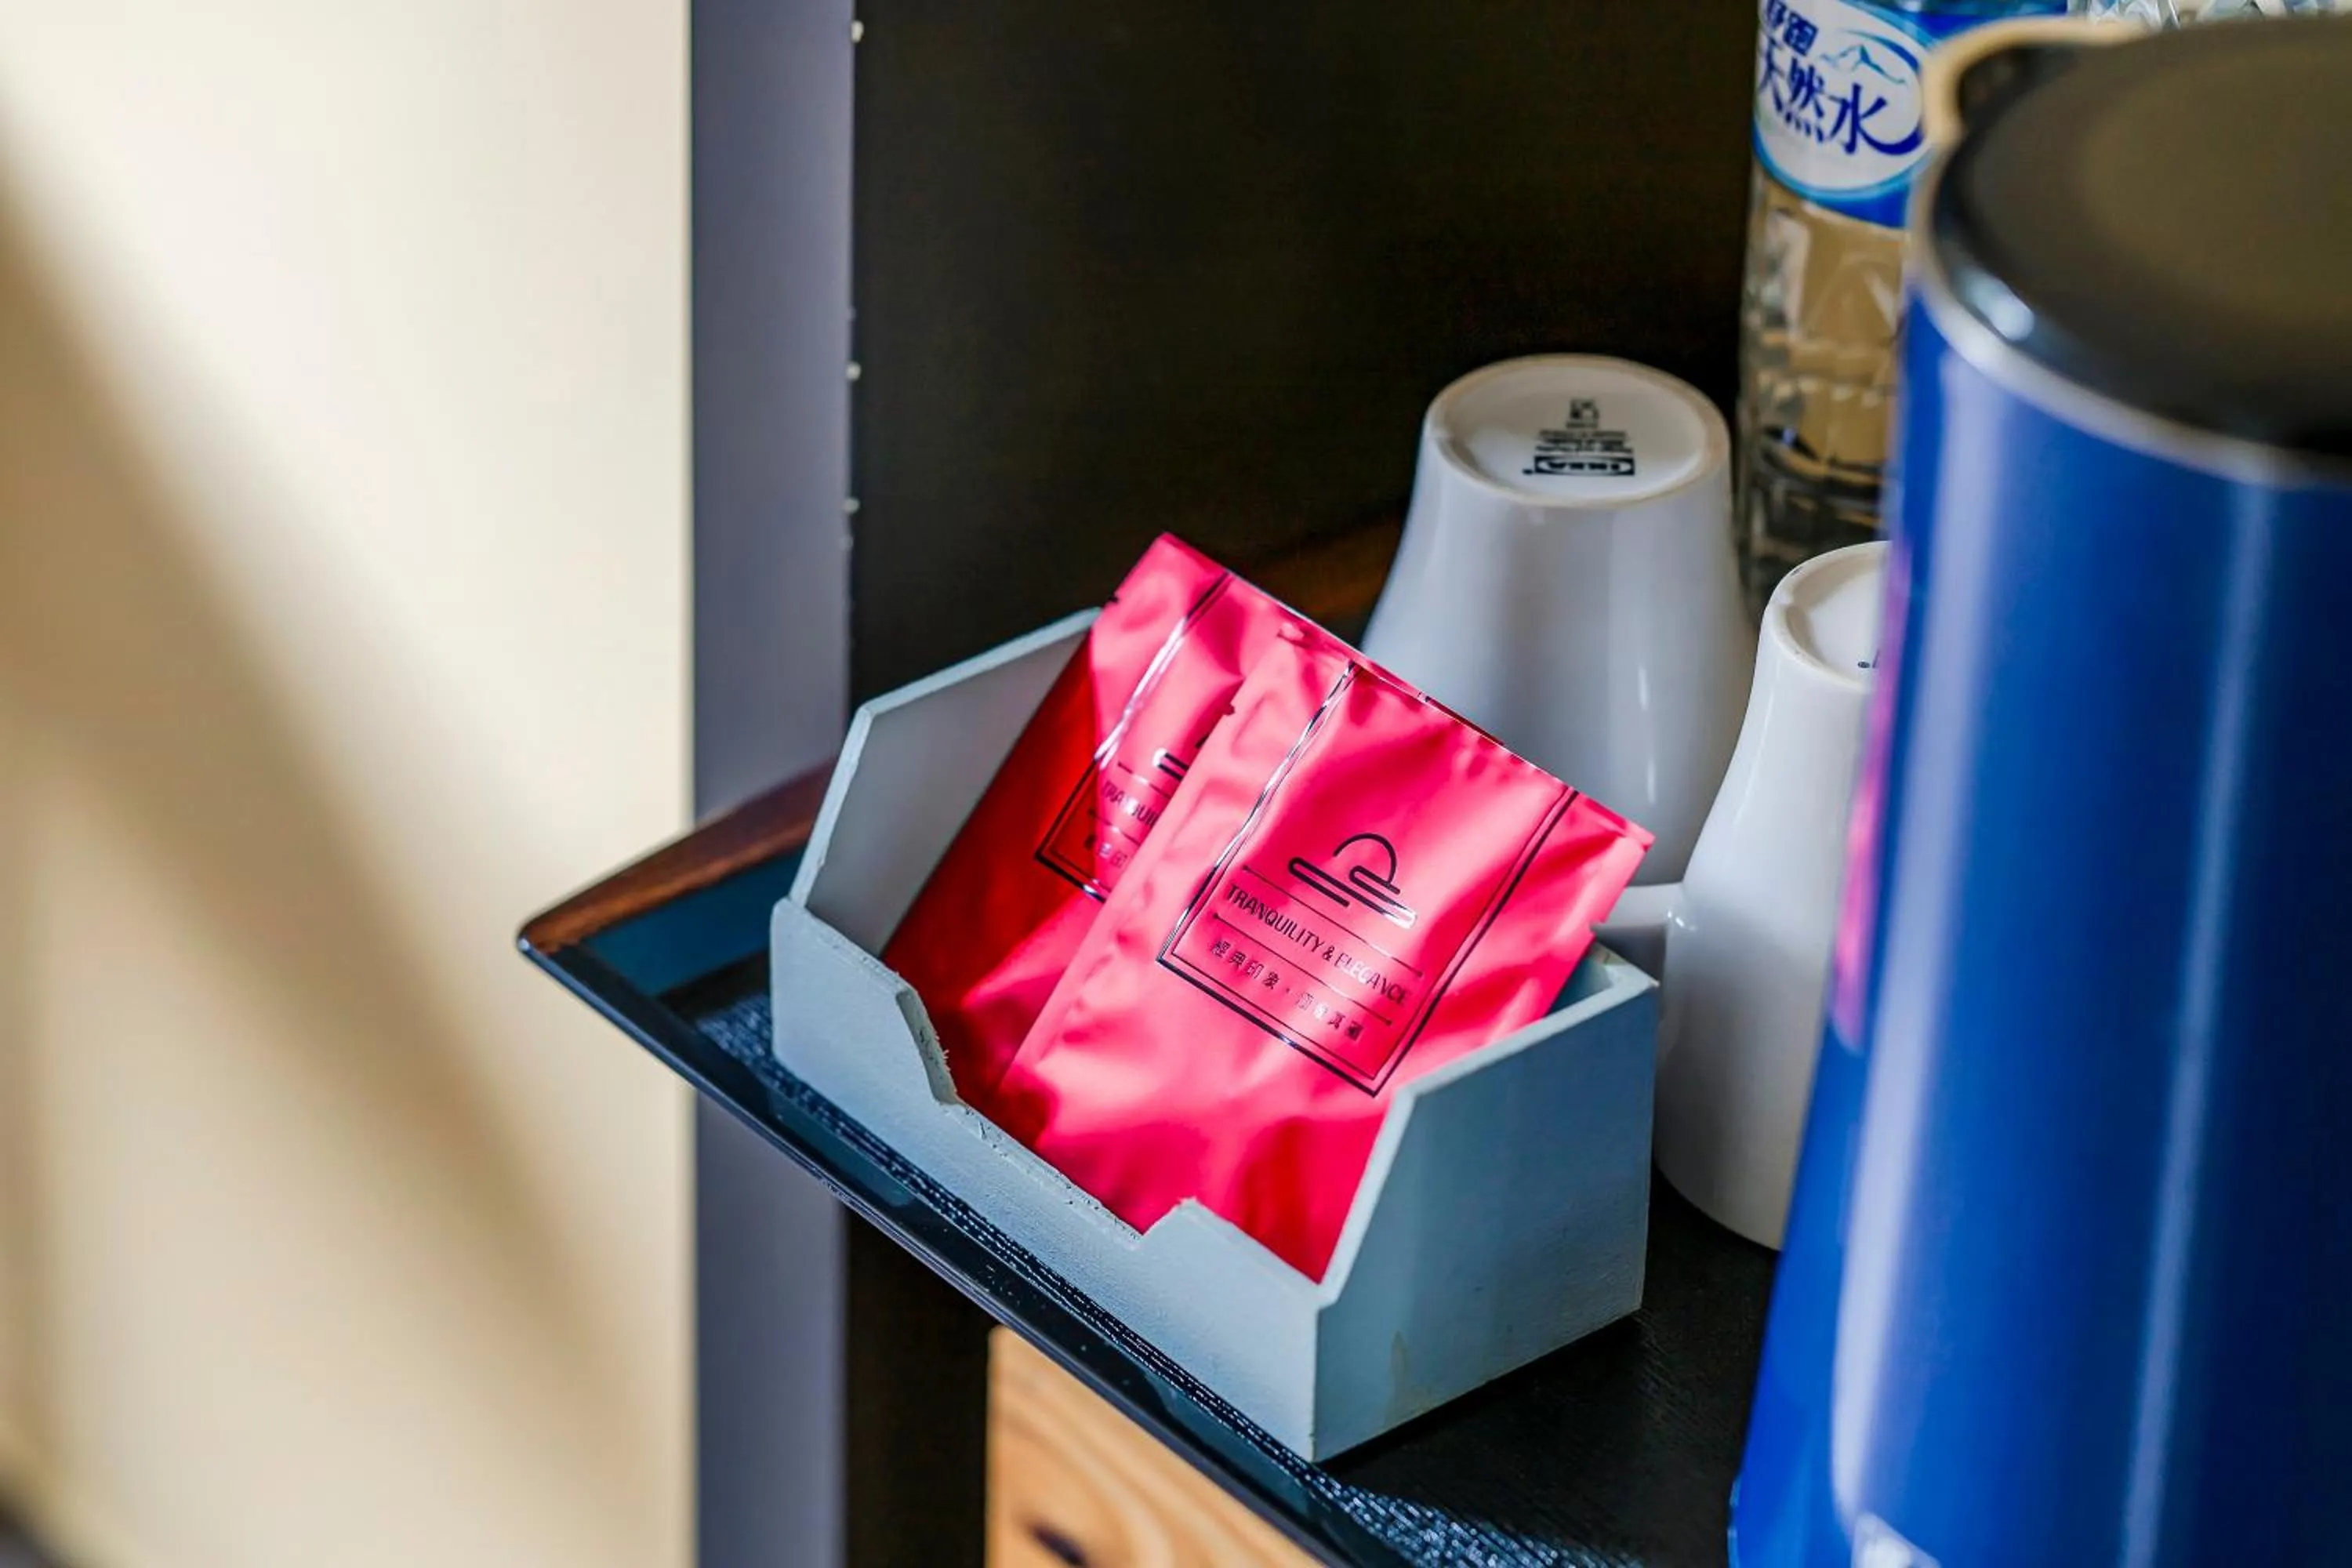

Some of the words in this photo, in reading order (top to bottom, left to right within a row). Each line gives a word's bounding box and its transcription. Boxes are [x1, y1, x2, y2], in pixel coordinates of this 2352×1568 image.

[1758, 36, 1925, 155] 天然水
[1225, 884, 1323, 953] TRANQUILITY
[1322, 946, 1334, 962] &
[1334, 951, 1410, 1006] ELEGANCE
